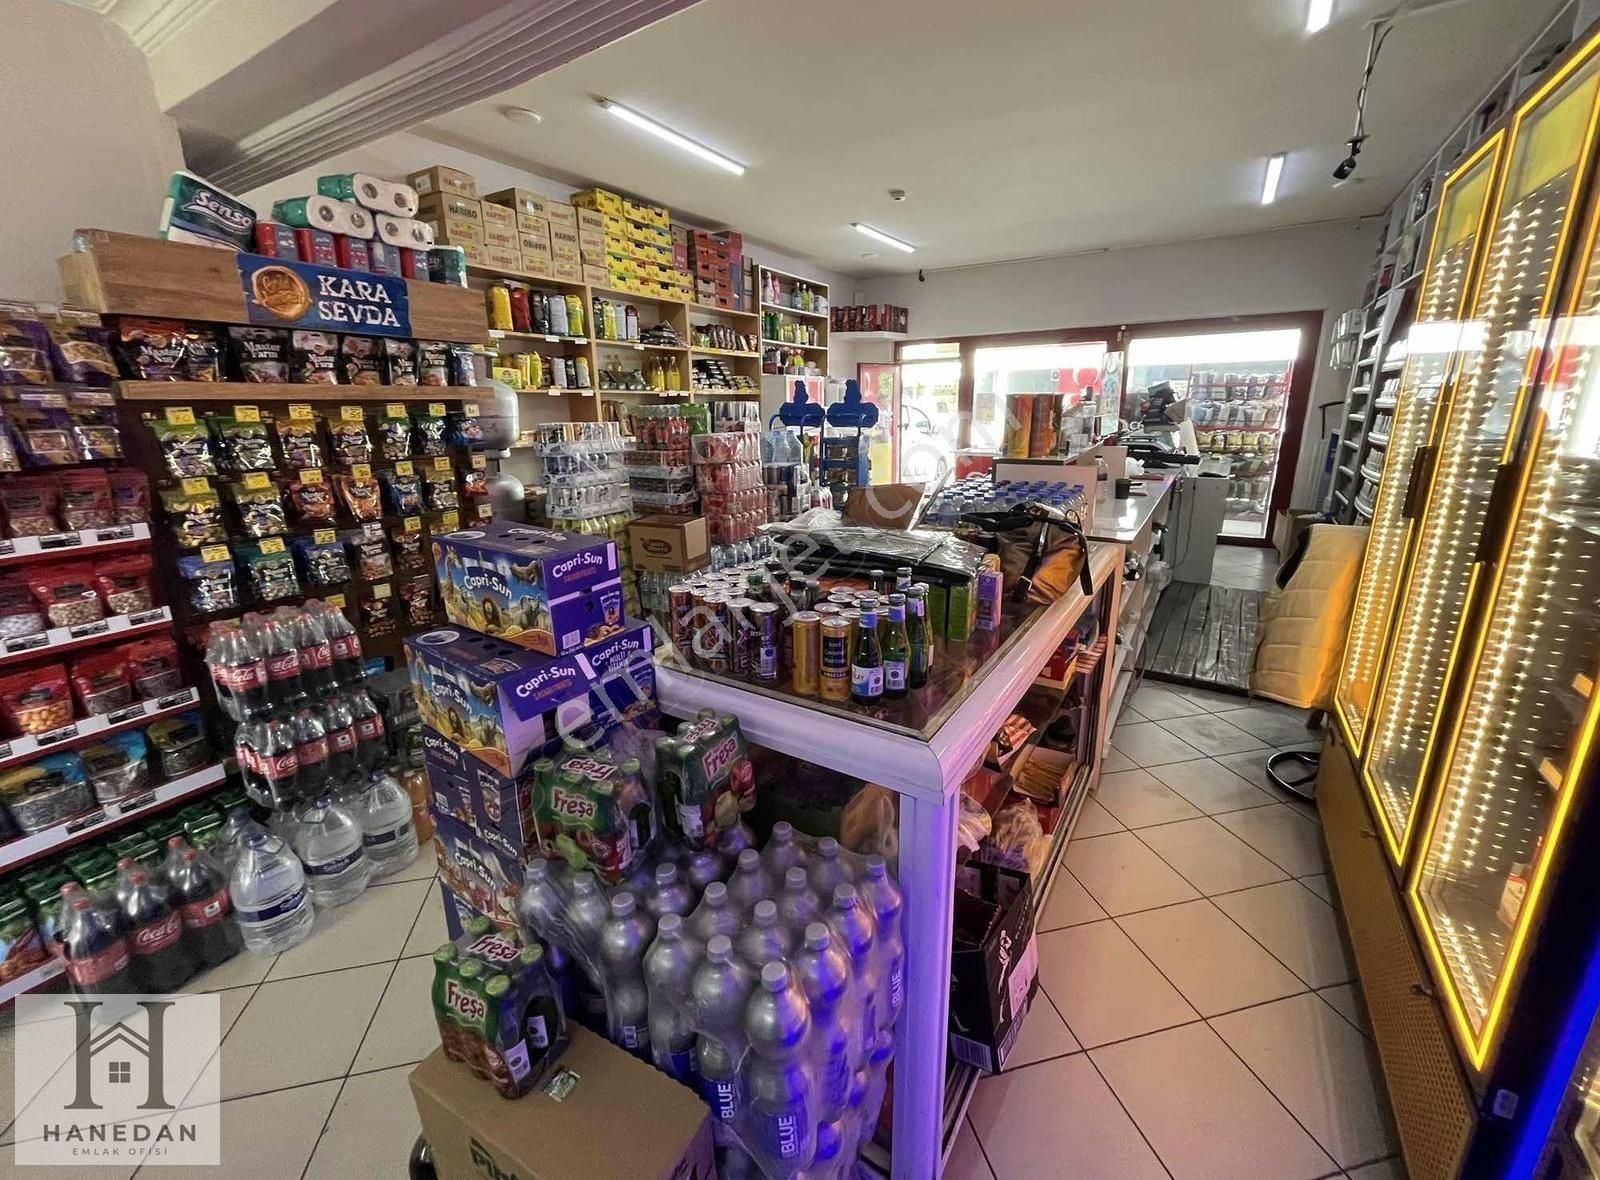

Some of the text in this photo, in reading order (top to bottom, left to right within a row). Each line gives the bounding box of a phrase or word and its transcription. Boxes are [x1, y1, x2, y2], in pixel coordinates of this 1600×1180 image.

[448, 204, 478, 219] HARIBO
[317, 274, 392, 304] KARA
[318, 300, 401, 327] SEVDA
[553, 552, 603, 578] Capri-Sun
[463, 574, 513, 600] Capri-Sun
[592, 639, 639, 667] Capri-Sun
[515, 666, 576, 698] Capri-Sun
[431, 681, 473, 715] Capri-Sun
[424, 736, 460, 761] Capri-Sun
[454, 851, 497, 891] Capri-Sun
[717, 1083, 734, 1119] BLUE
[778, 1115, 795, 1154] BLUE
